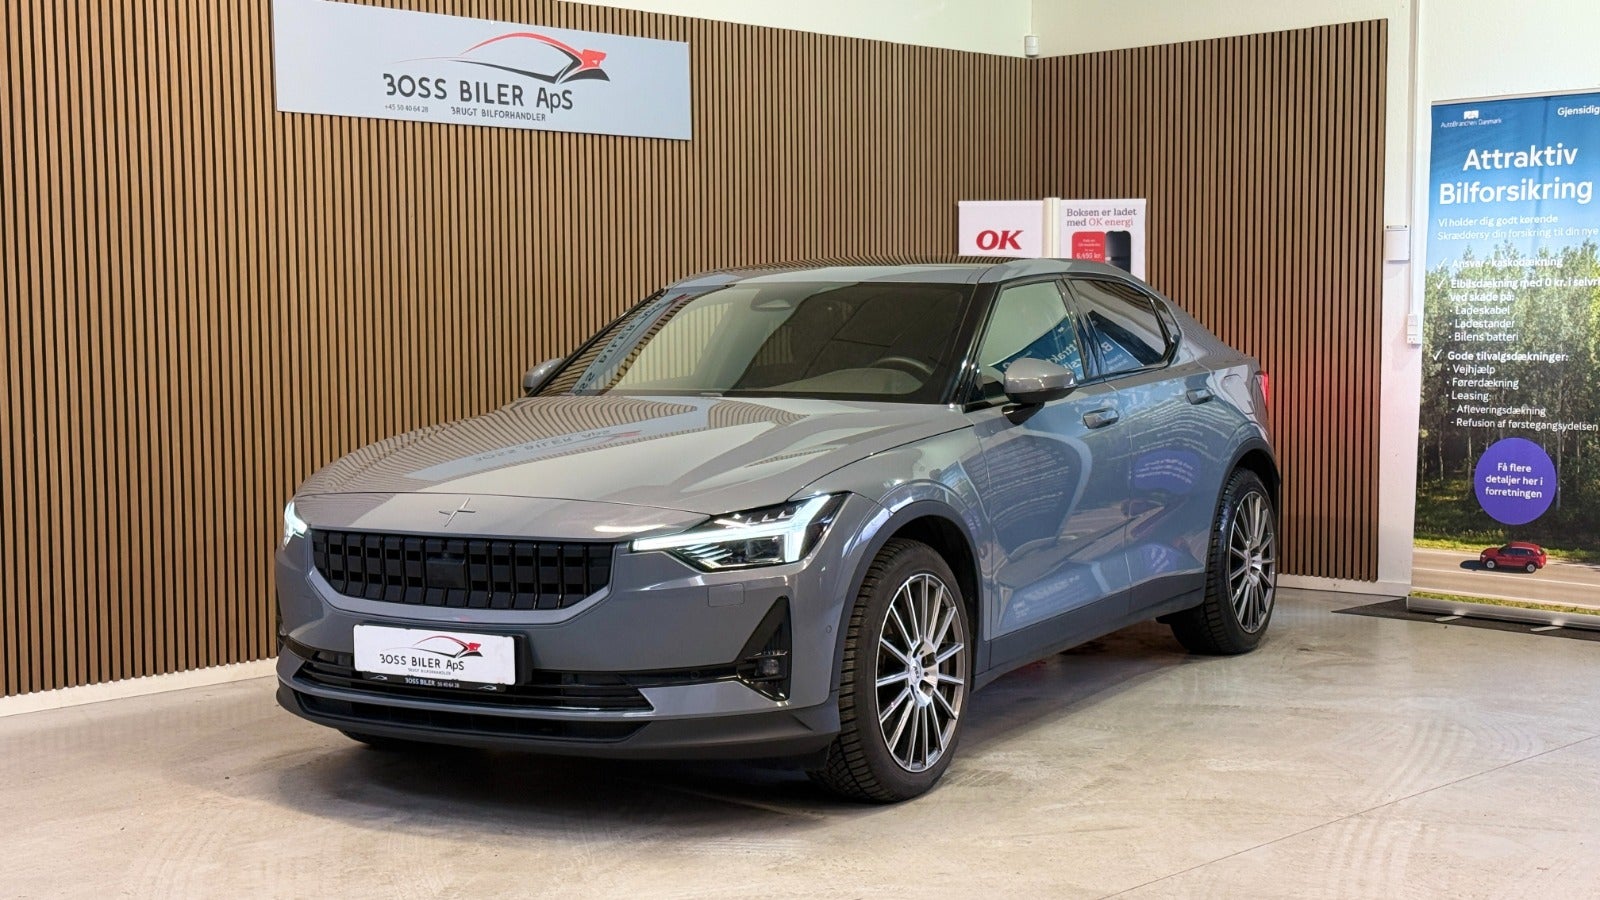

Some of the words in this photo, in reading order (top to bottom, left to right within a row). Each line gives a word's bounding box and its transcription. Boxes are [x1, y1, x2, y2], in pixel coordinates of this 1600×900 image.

[383, 73, 447, 100] BOSS
[459, 80, 524, 107] BILER
[536, 86, 574, 113] ApS
[405, 104, 412, 112] 40
[482, 109, 546, 122] BILFORHANDLER
[1478, 118, 1502, 126] Danmark
[1463, 142, 1578, 171] Attraktiv
[1439, 177, 1592, 205] Bilforsikring
[1066, 208, 1099, 216] Boksen
[1114, 208, 1137, 216] ladet
[1066, 218, 1086, 226] med
[1089, 218, 1103, 226] OK
[1104, 218, 1134, 228] energi
[1438, 218, 1448, 227] Vi
[1449, 217, 1478, 227] holder
[1480, 217, 1494, 228] dig
[1496, 216, 1518, 228] godt
[1438, 230, 1489, 240] Skræddersy
[1491, 230, 1506, 238] din
[1508, 229, 1551, 239] forsikring
[1554, 228, 1563, 237] til
[1565, 228, 1580, 236] din
[1582, 228, 1598, 237] nye
[976, 230, 1024, 251] OK
[1492, 257, 1563, 268] kaskodækning
[1451, 279, 1518, 289] Elbilsdækning
[1520, 278, 1542, 287] med
[1545, 278, 1552, 286] 0
[1554, 278, 1566, 286] kr.
[1450, 292, 1467, 301] ved
[1469, 292, 1498, 301] skade
[1500, 292, 1515, 302] på:
[1455, 305, 1510, 315] Ladeskabel
[1455, 319, 1515, 328] Ladestander
[1454, 332, 1484, 341] Bilens
[1487, 332, 1518, 341] batteri
[1448, 351, 1474, 361] Gode
[1476, 351, 1568, 363] tilvalgsdækninger:
[1453, 365, 1495, 375] Vejhjælp
[1452, 378, 1519, 389] Førerdækning
[1452, 391, 1491, 402] Leasing:
[1456, 405, 1546, 417] Afleveringsdækning
[1456, 418, 1495, 428] Refusion
[1497, 419, 1506, 428] af
[1508, 419, 1598, 432] førstegangsydelsen
[1498, 463, 1508, 472] Få
[1510, 463, 1532, 473] flere
[1486, 475, 1520, 486] detaljer
[1522, 476, 1538, 485] her
[1540, 477, 1543, 486] i
[1485, 487, 1542, 499] forretningen
[379, 654, 406, 665] BOSS
[411, 656, 441, 668] BILER
[446, 660, 464, 672] ApS
[420, 678, 435, 686] BILER
